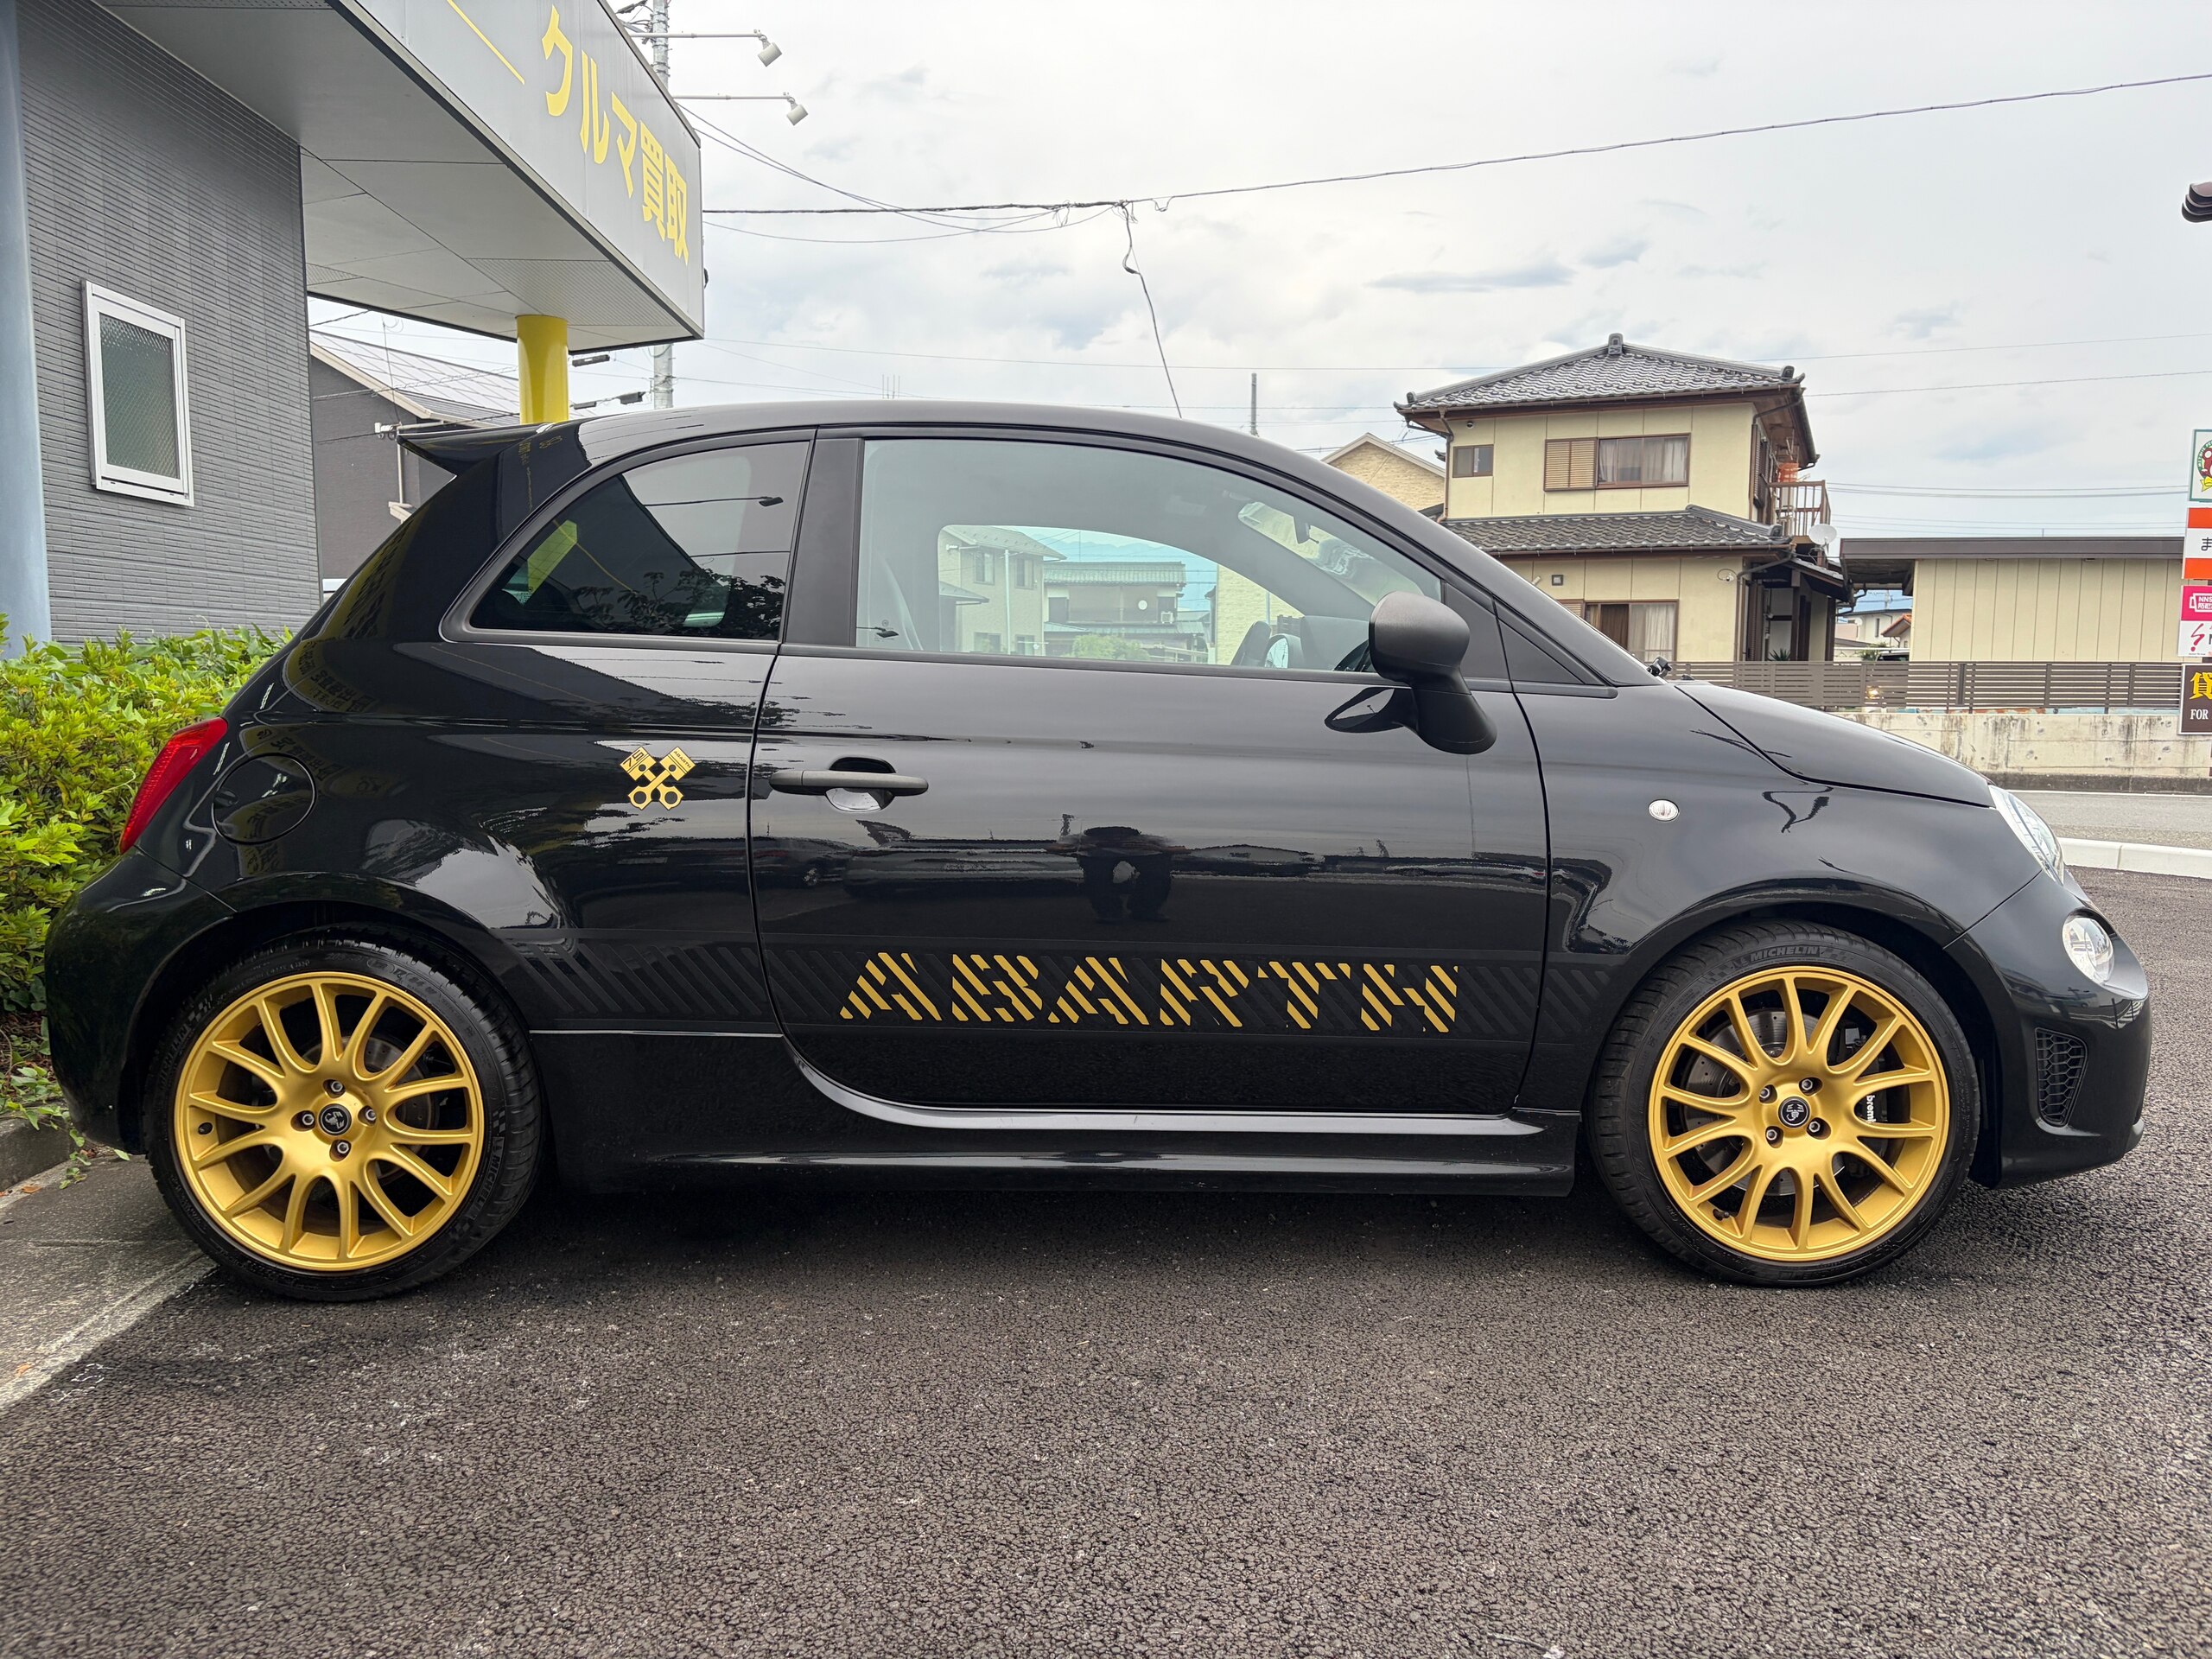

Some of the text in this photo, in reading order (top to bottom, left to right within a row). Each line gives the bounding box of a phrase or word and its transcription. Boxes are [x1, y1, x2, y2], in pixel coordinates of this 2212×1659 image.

[541, 4, 689, 266] クルマ買取
[2190, 709, 2209, 720] FOR
[623, 749, 645, 767] 75
[673, 750, 691, 769] ABARTH
[1751, 946, 1818, 961] MICHELIN
[839, 952, 1459, 1033] ABARTH
[1866, 1095, 1876, 1123] brem
